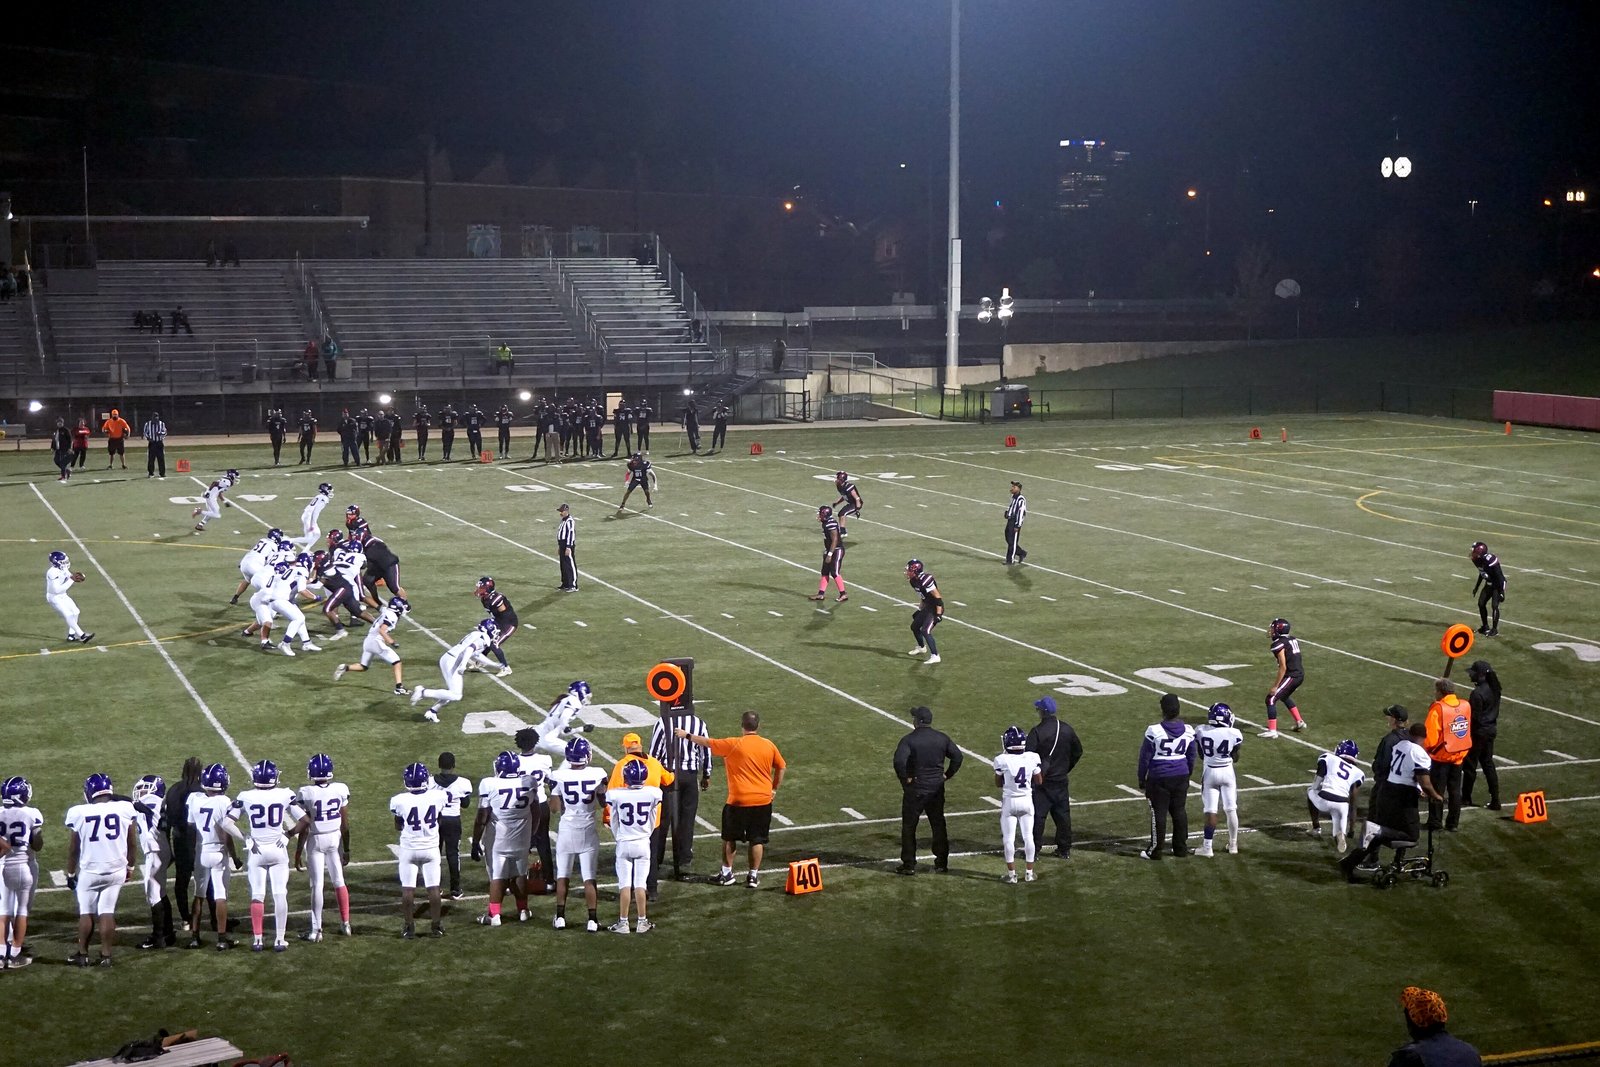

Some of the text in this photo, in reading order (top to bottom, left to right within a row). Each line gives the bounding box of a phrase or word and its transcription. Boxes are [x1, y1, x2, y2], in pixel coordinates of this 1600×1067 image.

[1007, 436, 1016, 445] 10
[1252, 429, 1260, 438] G
[254, 540, 268, 554] 51
[336, 552, 355, 565] 64
[1288, 639, 1301, 654] 10
[1027, 666, 1235, 697] 30
[462, 703, 658, 735] 40
[1157, 738, 1187, 756] 54
[1201, 736, 1229, 759] 84
[1336, 761, 1351, 781] 5
[1390, 748, 1406, 777] 71
[1014, 767, 1027, 789] 4
[498, 787, 530, 810] 75
[564, 780, 596, 805] 55
[249, 803, 284, 829] 20
[313, 798, 341, 822] 12
[406, 805, 437, 831] 44
[619, 802, 651, 826] 35
[1523, 794, 1545, 818] 30
[85, 813, 120, 842] 79
[199, 808, 213, 832] 7
[796, 863, 820, 889] 40
